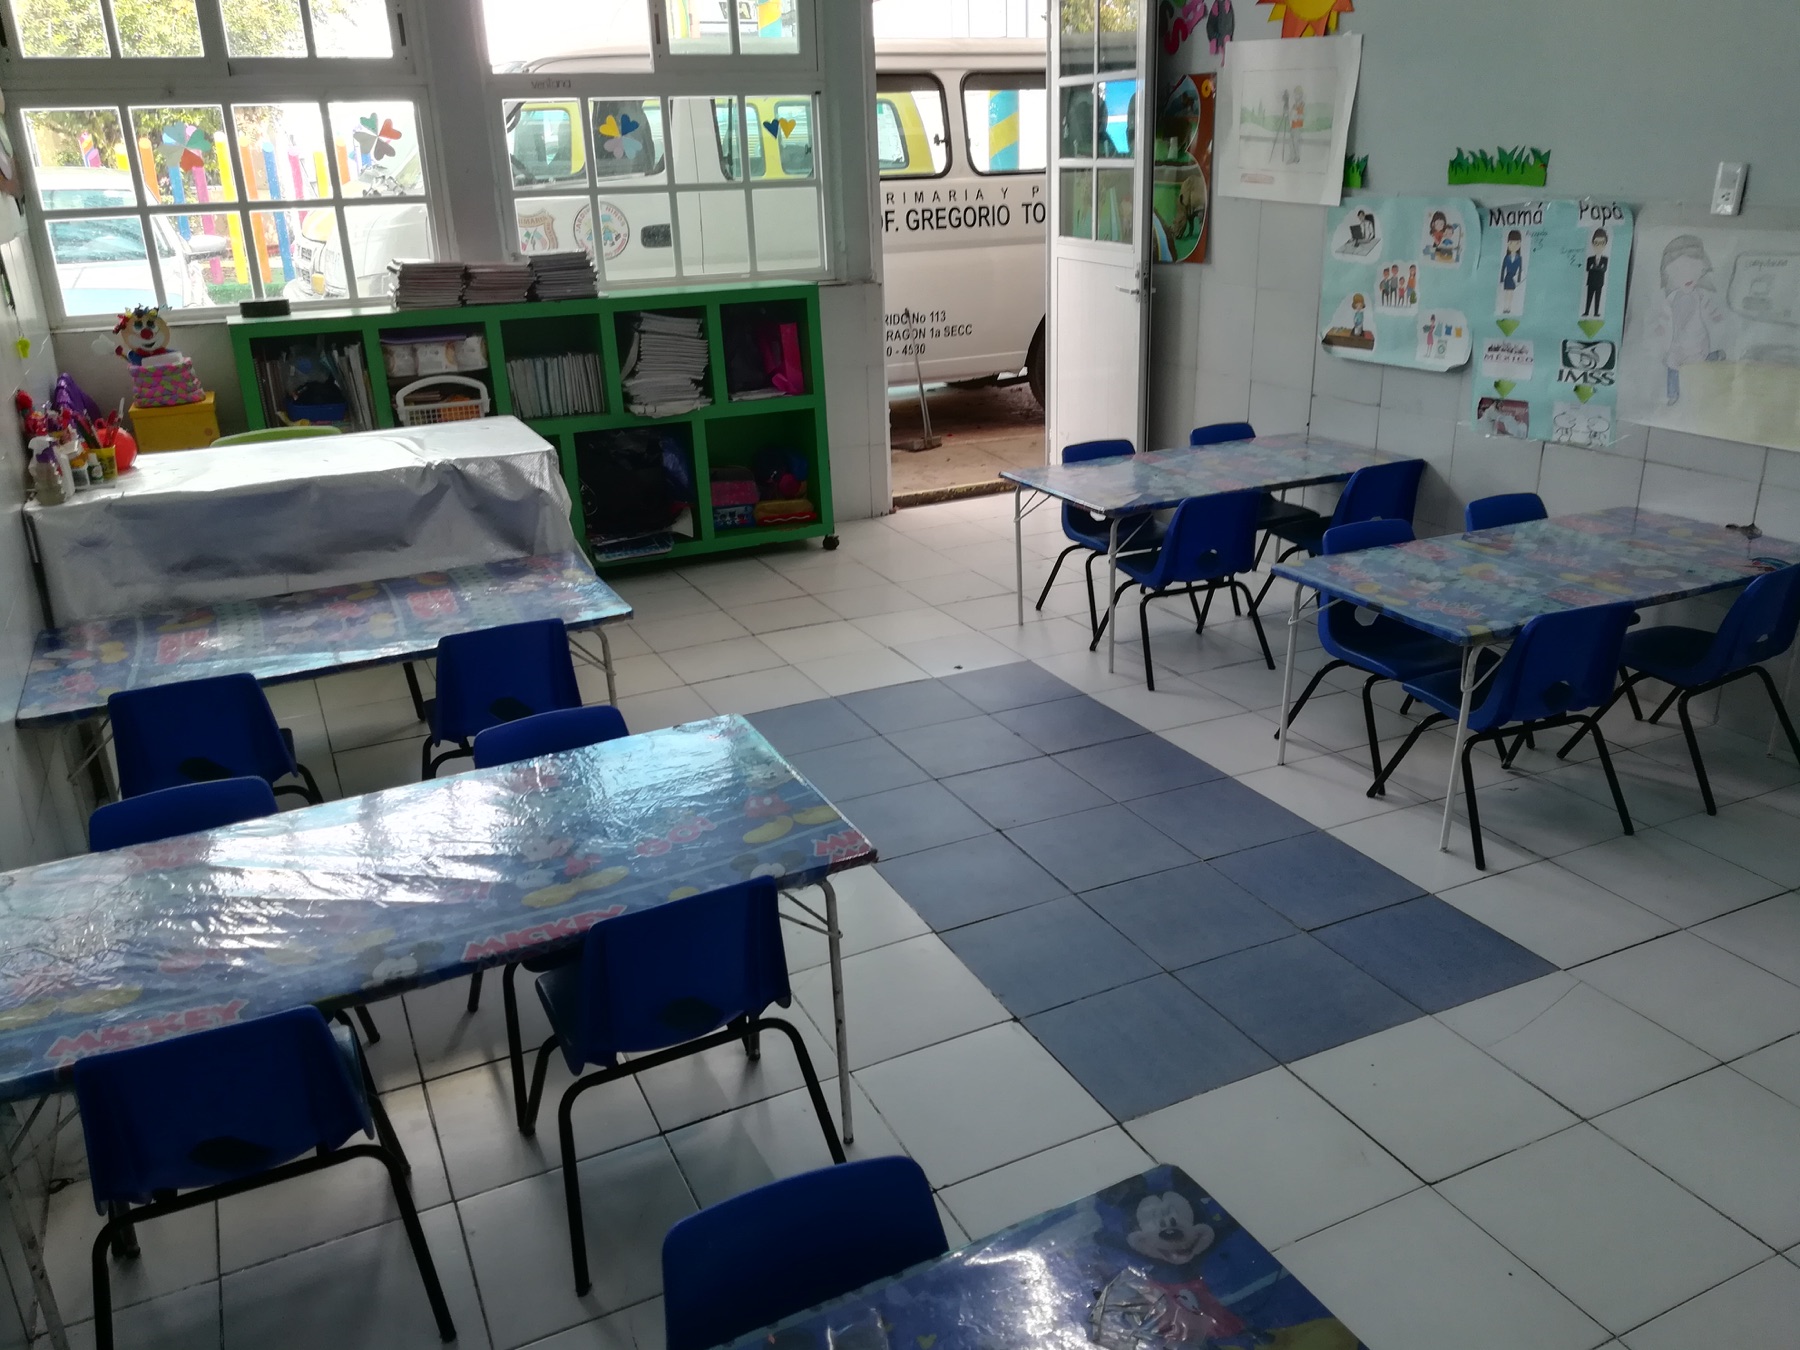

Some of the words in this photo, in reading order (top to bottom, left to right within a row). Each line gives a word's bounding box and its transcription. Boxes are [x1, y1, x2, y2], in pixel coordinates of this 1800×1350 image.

[1001, 187, 1009, 199] Y
[881, 210, 899, 232] F.
[906, 205, 1011, 231] GREGORIO
[1489, 202, 1543, 227] Mamá
[1579, 200, 1624, 227] Papá
[912, 312, 926, 324] No
[930, 310, 946, 322] 113
[944, 324, 973, 337] SECC
[1557, 369, 1616, 386] IMSS
[462, 905, 628, 962] MICKEY
[44, 999, 249, 1059] MICKEY
